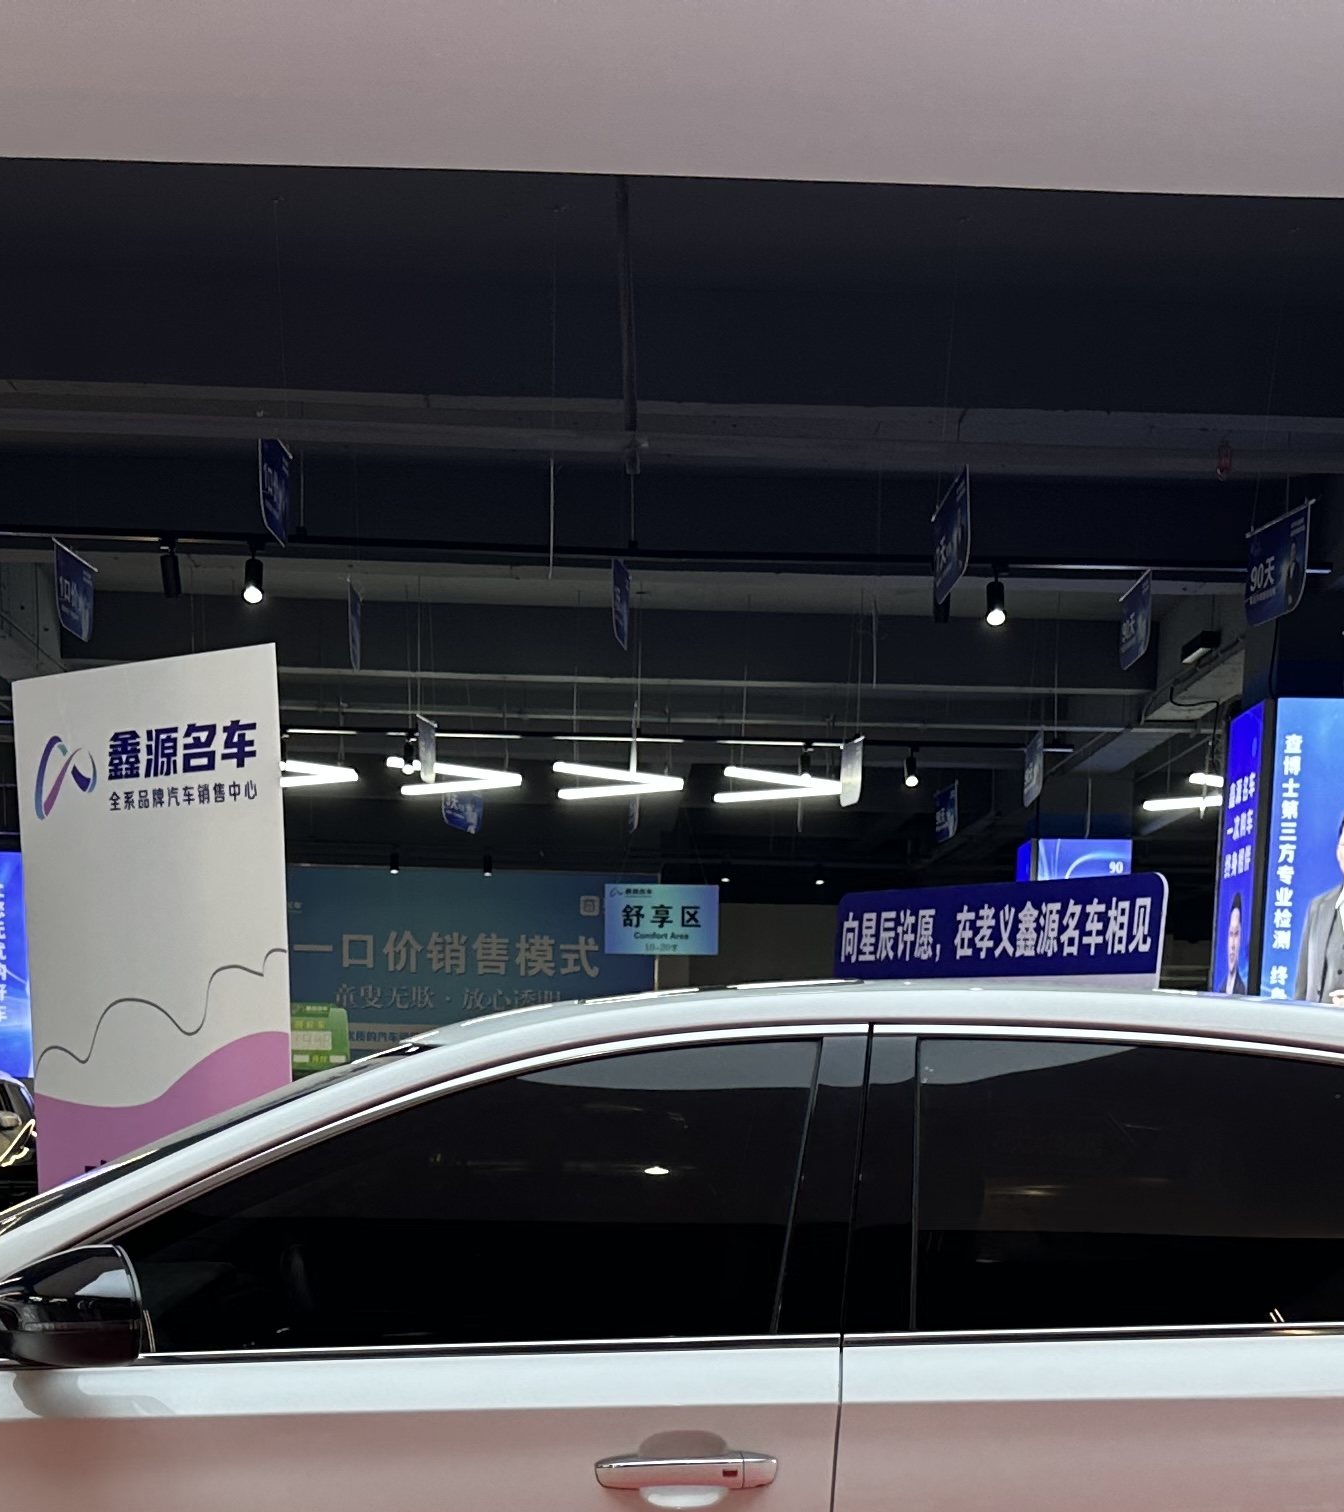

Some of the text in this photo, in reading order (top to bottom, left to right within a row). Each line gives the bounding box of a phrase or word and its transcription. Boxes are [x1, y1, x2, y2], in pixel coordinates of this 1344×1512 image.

[1250, 556, 1275, 592] 90天
[108, 720, 258, 780] 鑫源名车
[108, 780, 258, 812] 全系品牌汽车销售中心
[1271, 734, 1304, 950] 查博士第三方专业检测
[1109, 861, 1124, 874] 90
[621, 904, 702, 928] 舒享区
[840, 896, 1152, 964] 向星辰许愿，在孝义鑫源名车相见
[634, 931, 689, 940] Comfort Area
[293, 930, 599, 978] 一口价销售模式
